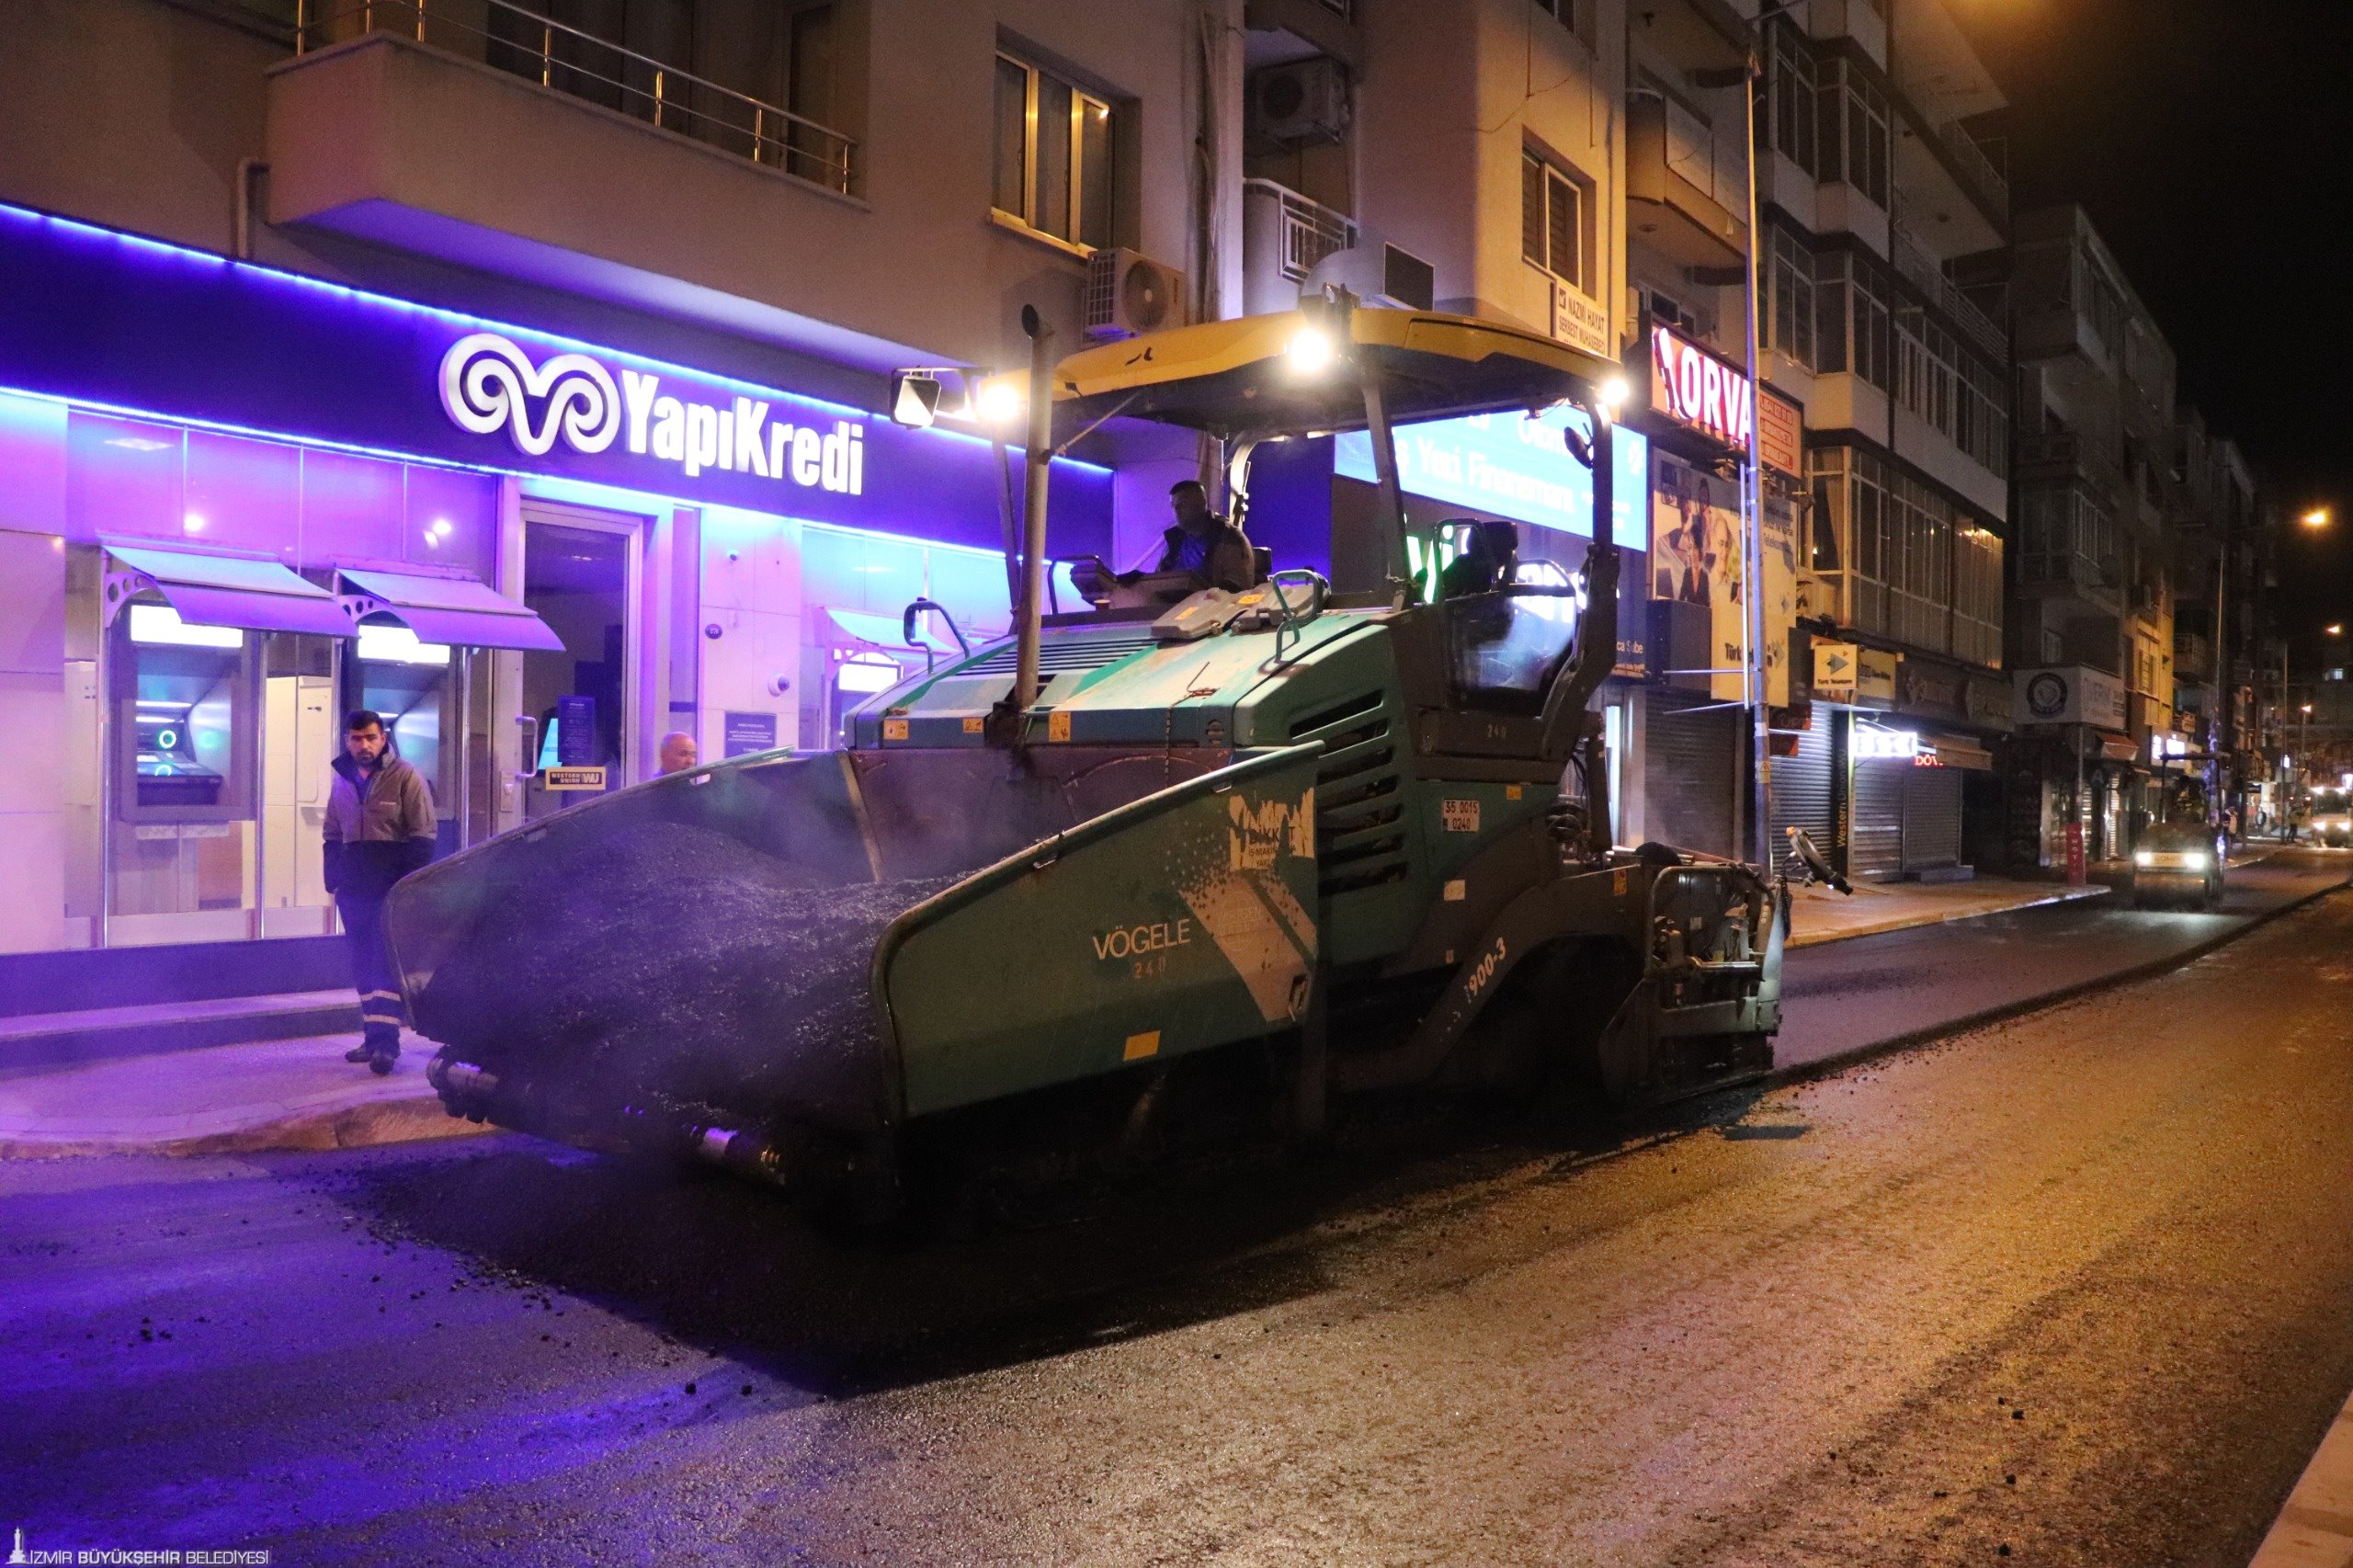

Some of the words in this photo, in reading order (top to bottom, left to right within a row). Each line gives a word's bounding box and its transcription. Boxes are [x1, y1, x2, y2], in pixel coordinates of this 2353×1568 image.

[620, 369, 864, 496] YapıKredi
[1446, 801, 1456, 813] 35
[1460, 801, 1478, 814] 0015
[1452, 817, 1471, 830] 0240
[1836, 803, 1847, 848] Western
[1093, 918, 1191, 960] VÖGELE
